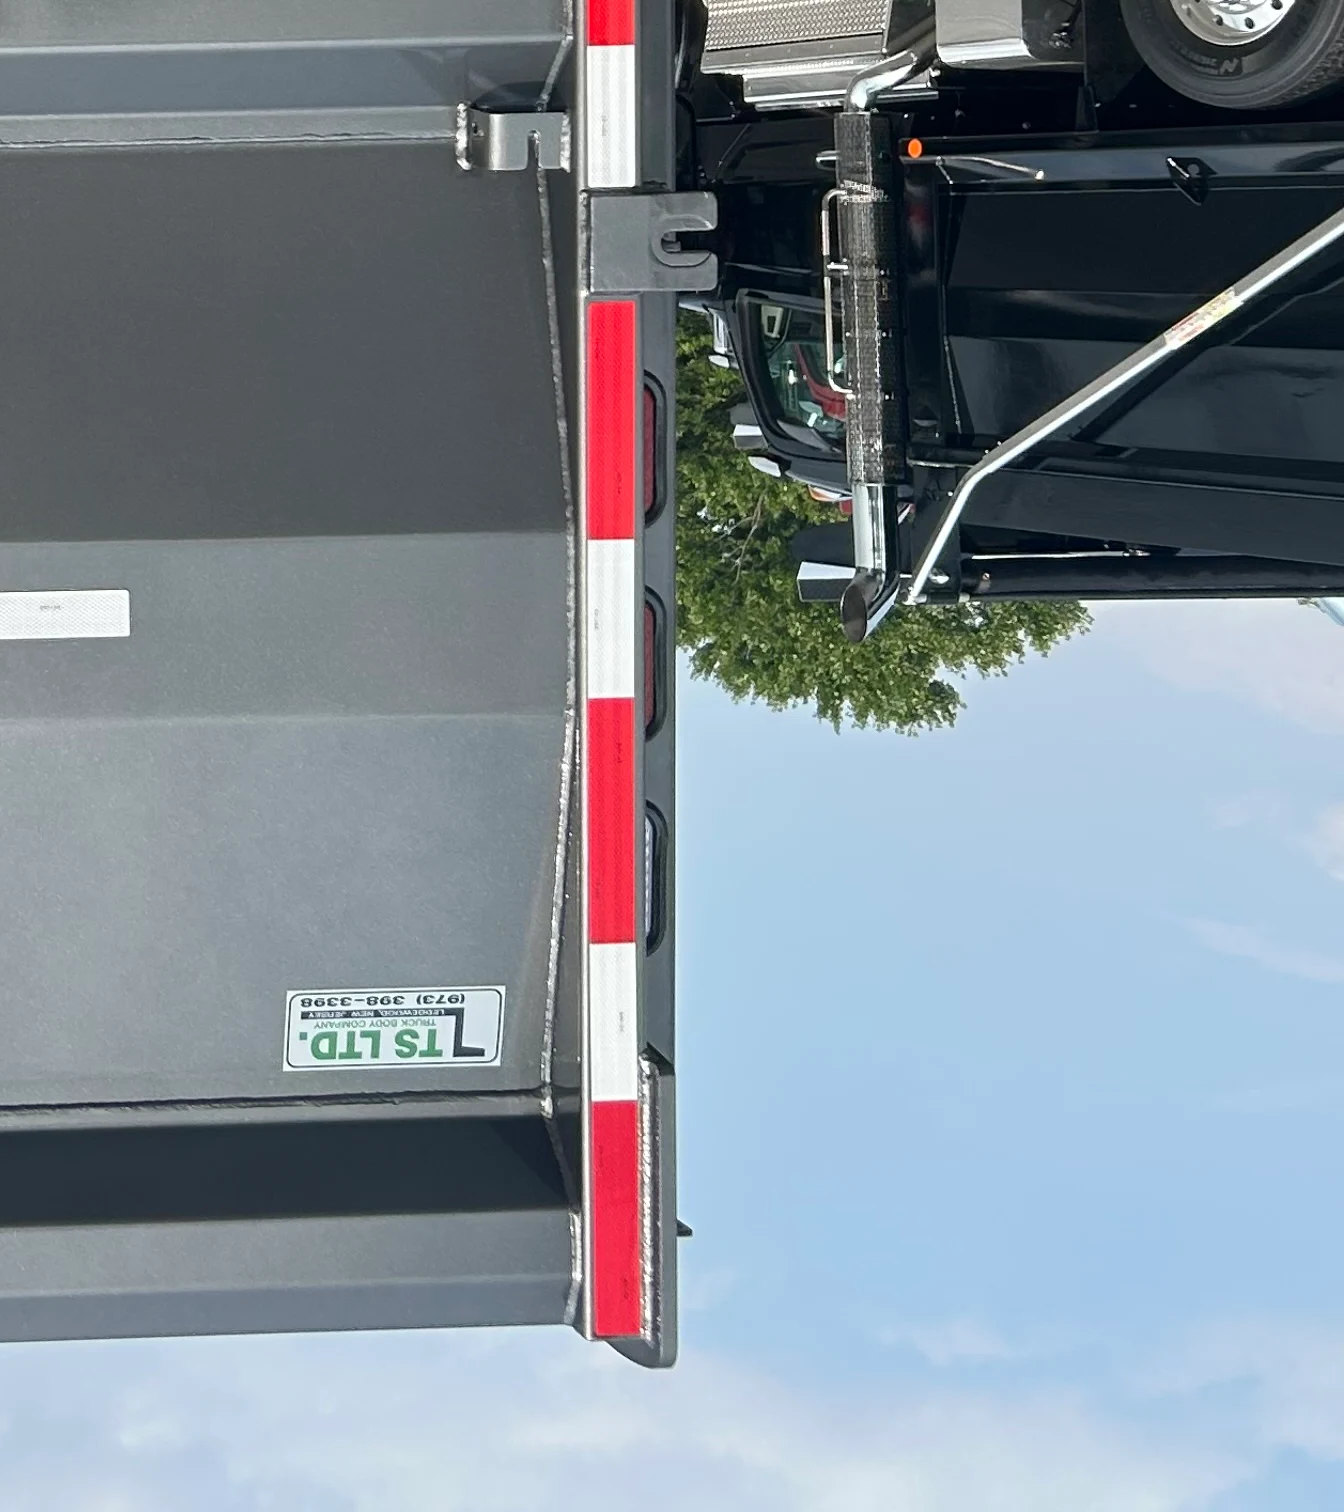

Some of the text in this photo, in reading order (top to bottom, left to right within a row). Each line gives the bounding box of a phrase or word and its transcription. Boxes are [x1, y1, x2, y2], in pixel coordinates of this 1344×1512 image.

[299, 993, 464, 1006] (973) 398-3398
[313, 1018, 435, 1027] TRUCK BODY COMPANY
[299, 1028, 441, 1059] TS LTD.
